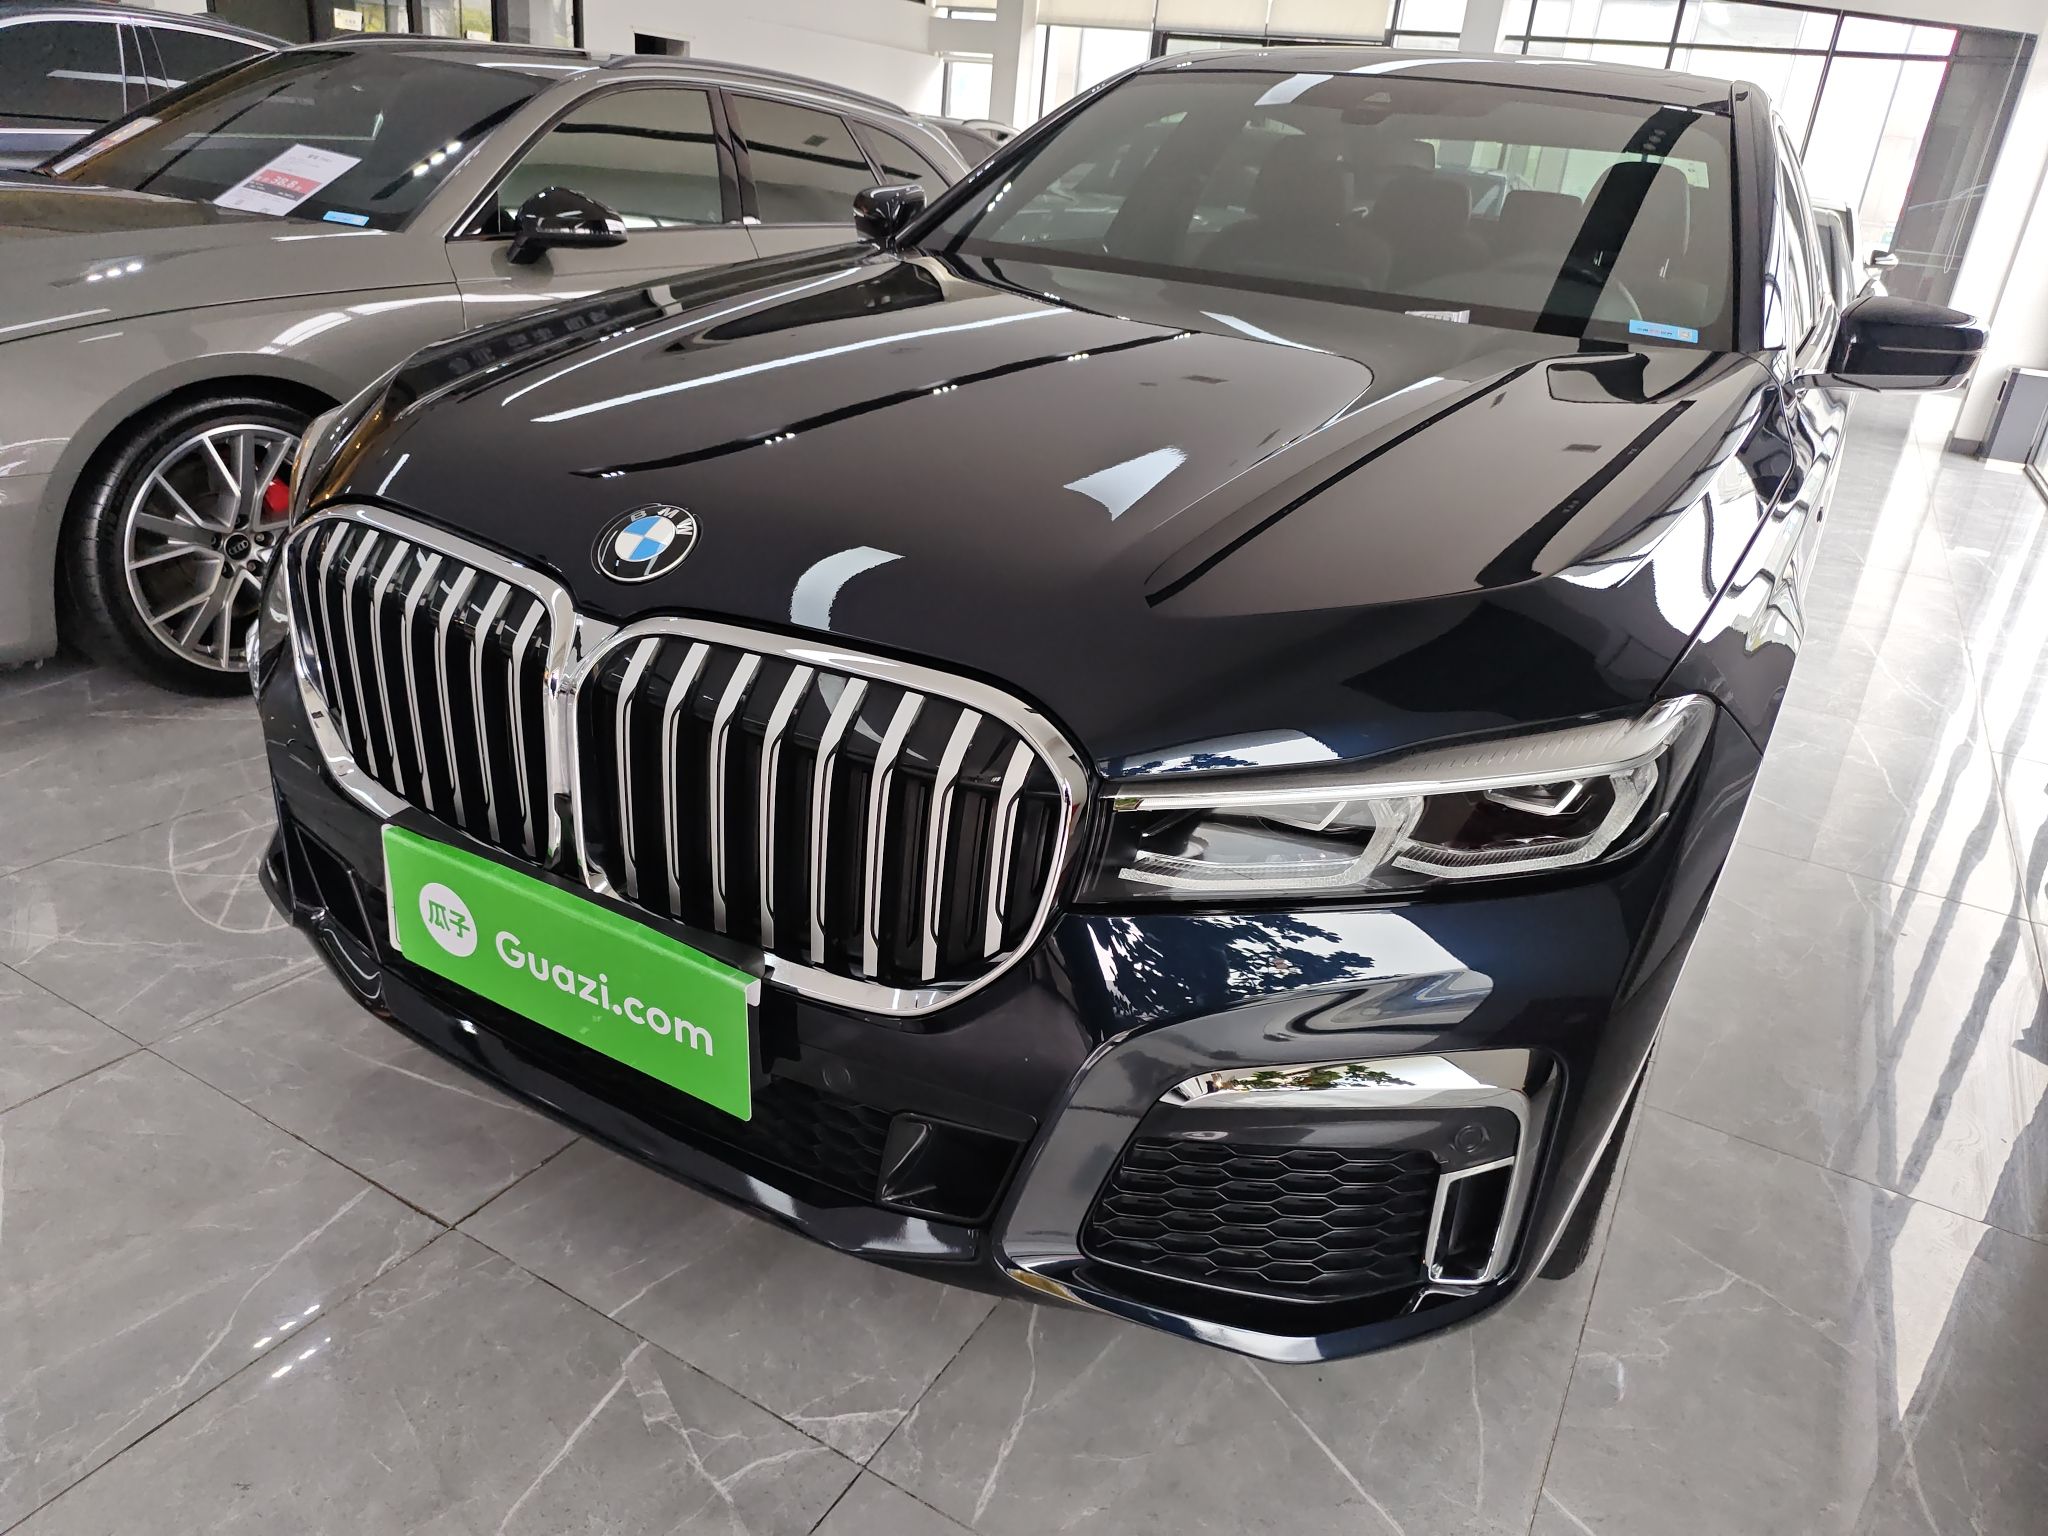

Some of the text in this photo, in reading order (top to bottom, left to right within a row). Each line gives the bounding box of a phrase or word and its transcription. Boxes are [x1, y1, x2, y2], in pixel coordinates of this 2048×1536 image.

[630, 507, 694, 536] BMW
[428, 899, 471, 939] 瓜子
[495, 930, 714, 1057] Guazi.com
